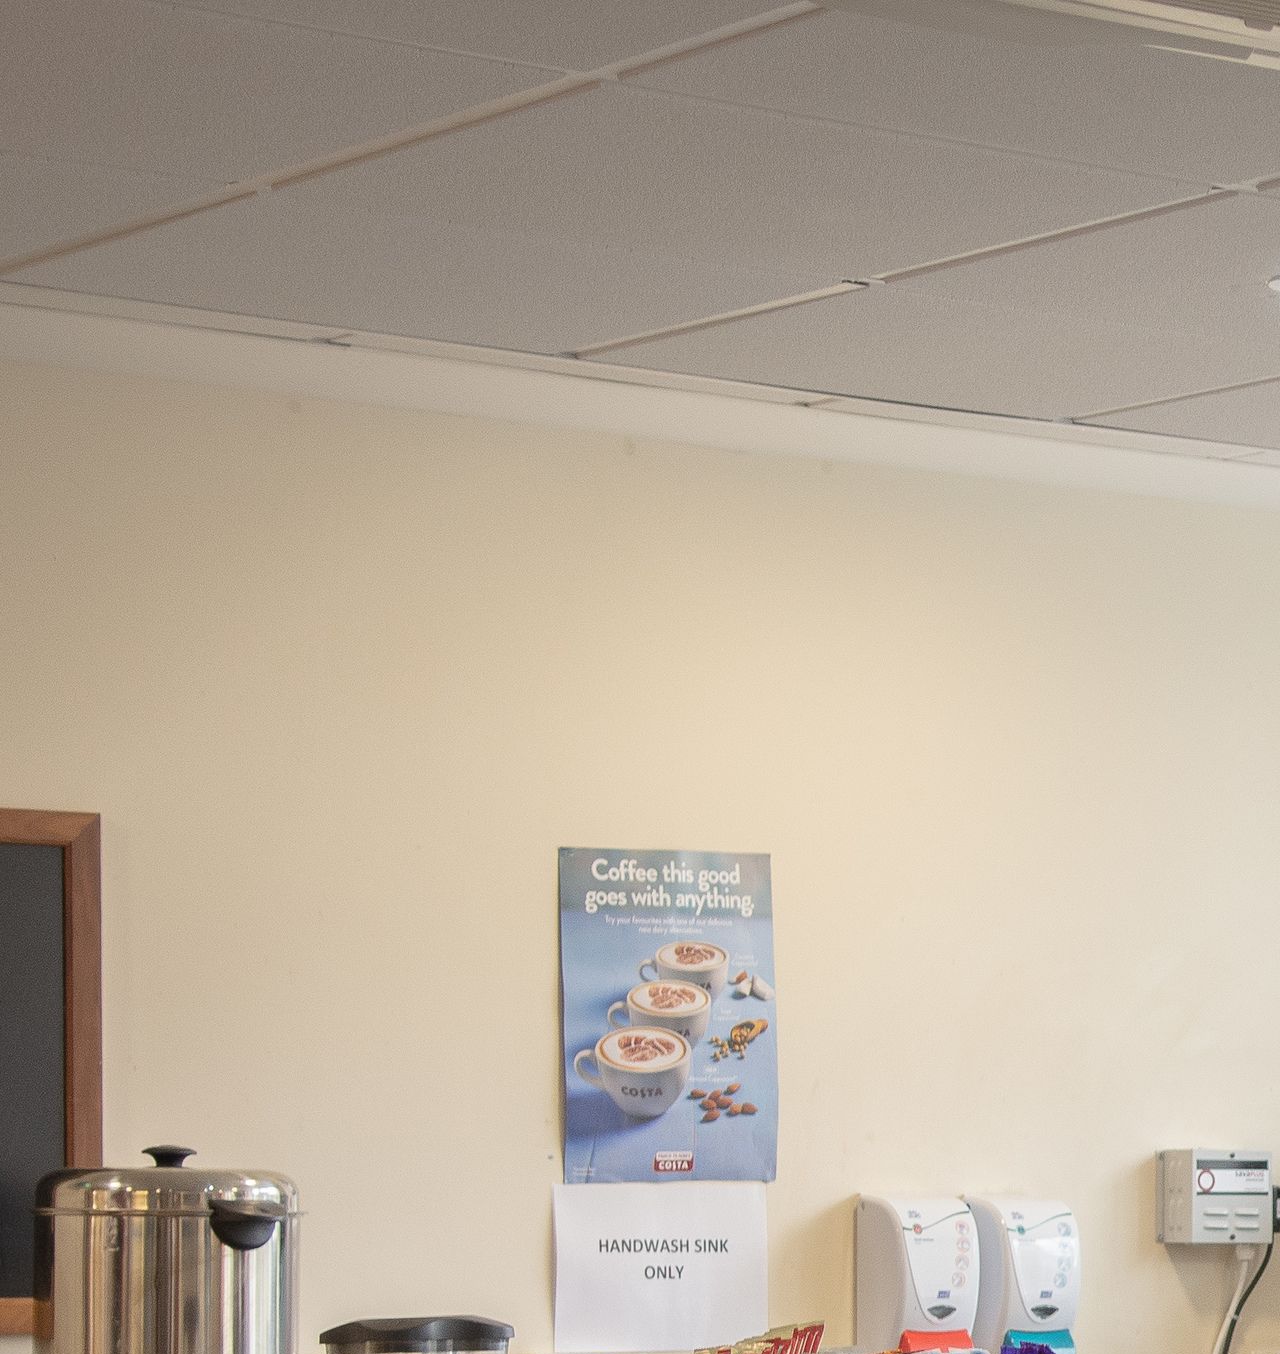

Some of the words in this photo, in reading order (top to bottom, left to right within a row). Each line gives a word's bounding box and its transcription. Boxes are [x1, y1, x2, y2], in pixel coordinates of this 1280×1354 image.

[591, 858, 657, 881] Coffee
[662, 861, 693, 882] this
[698, 864, 740, 892] good
[585, 889, 627, 913] goes
[632, 885, 671, 907] with
[676, 889, 755, 917] anything.
[621, 1086, 663, 1097] COSTA
[659, 1160, 689, 1170] COSTA
[599, 1239, 689, 1253] HANDWASH
[695, 1239, 728, 1253] SINK
[644, 1266, 684, 1279] ONLY
